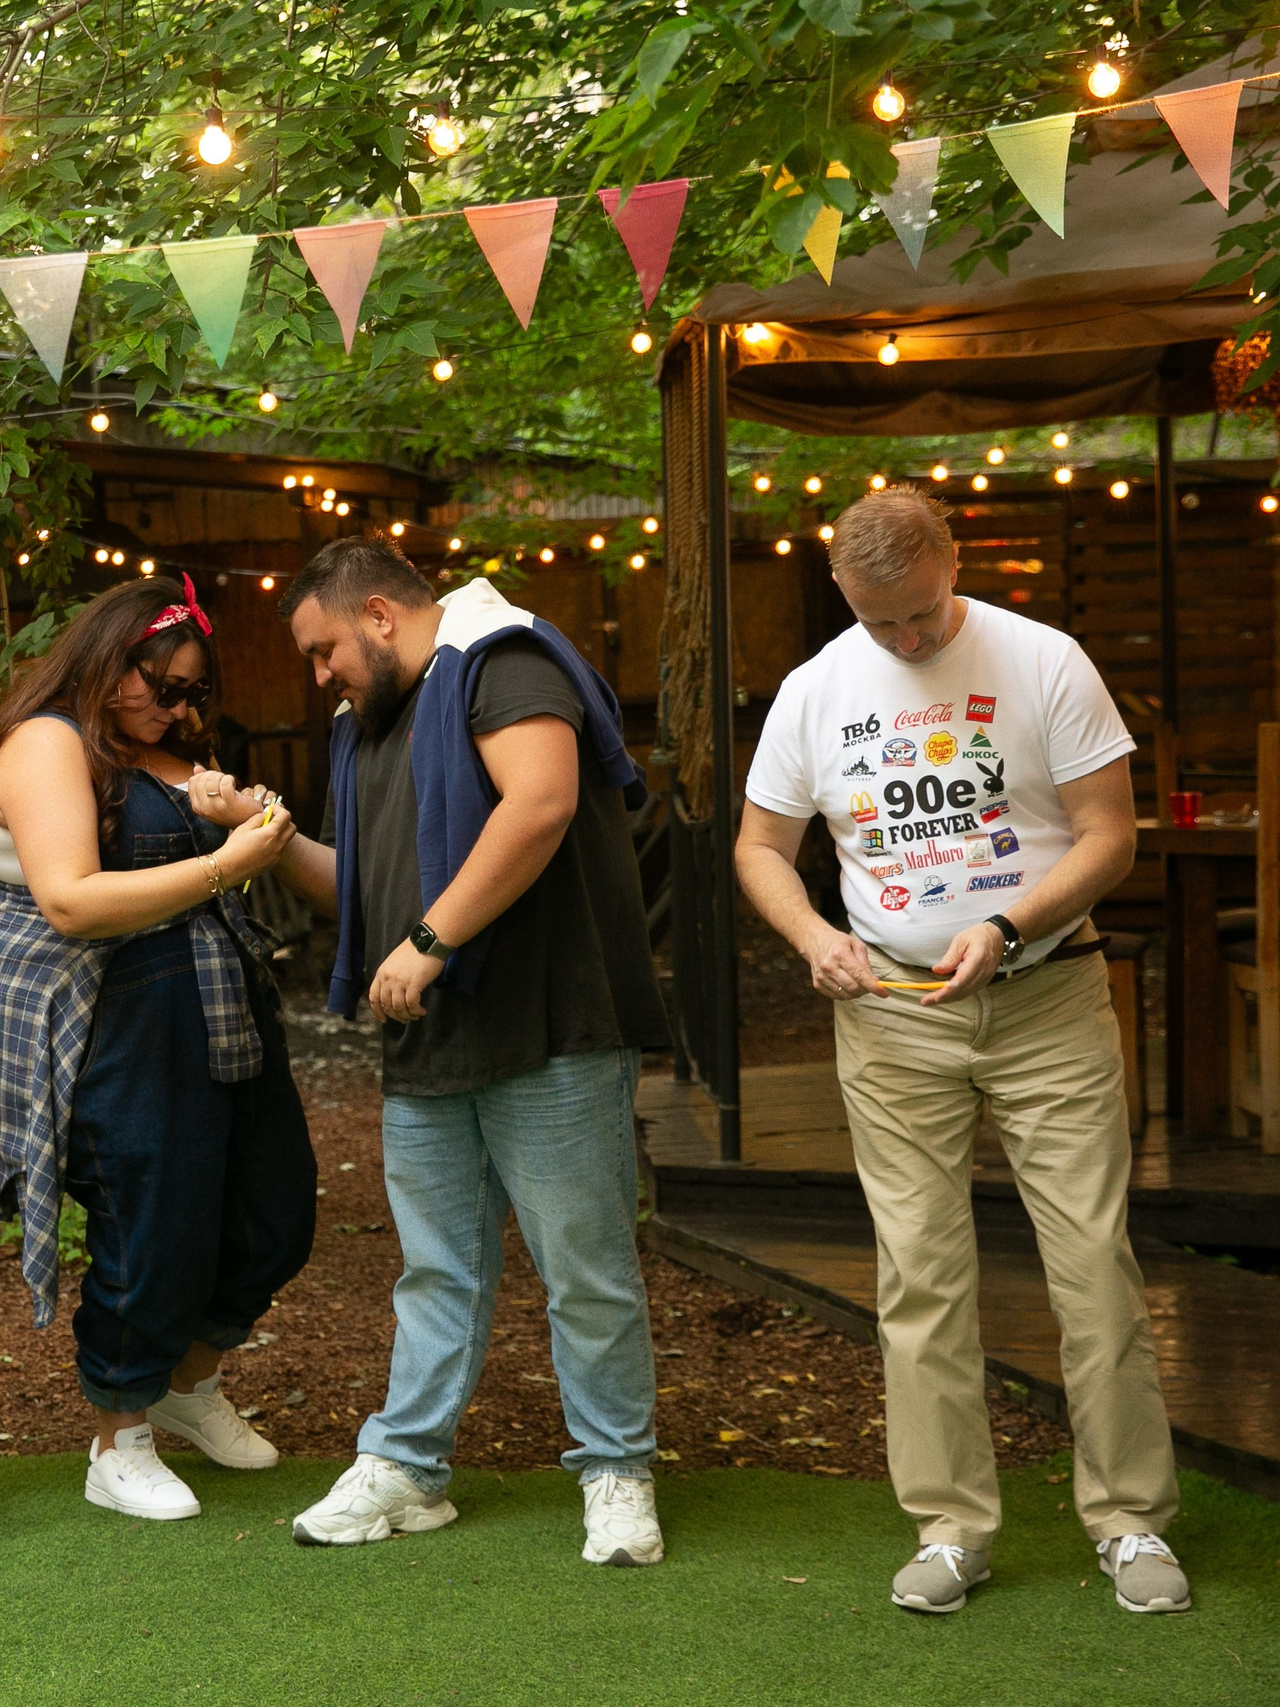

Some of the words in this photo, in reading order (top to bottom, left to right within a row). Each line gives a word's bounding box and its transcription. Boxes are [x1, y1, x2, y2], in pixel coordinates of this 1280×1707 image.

[969, 703, 993, 713] LEGO
[928, 739, 953, 749] Chupa
[928, 747, 953, 761] Chups
[962, 751, 999, 759] ЮКОС
[979, 800, 1008, 815] PEPSI
[888, 813, 979, 845] FOREVER
[904, 839, 964, 870] Marlboro
[969, 872, 1021, 891] SNICKERS
[918, 896, 944, 905] FRANCE
